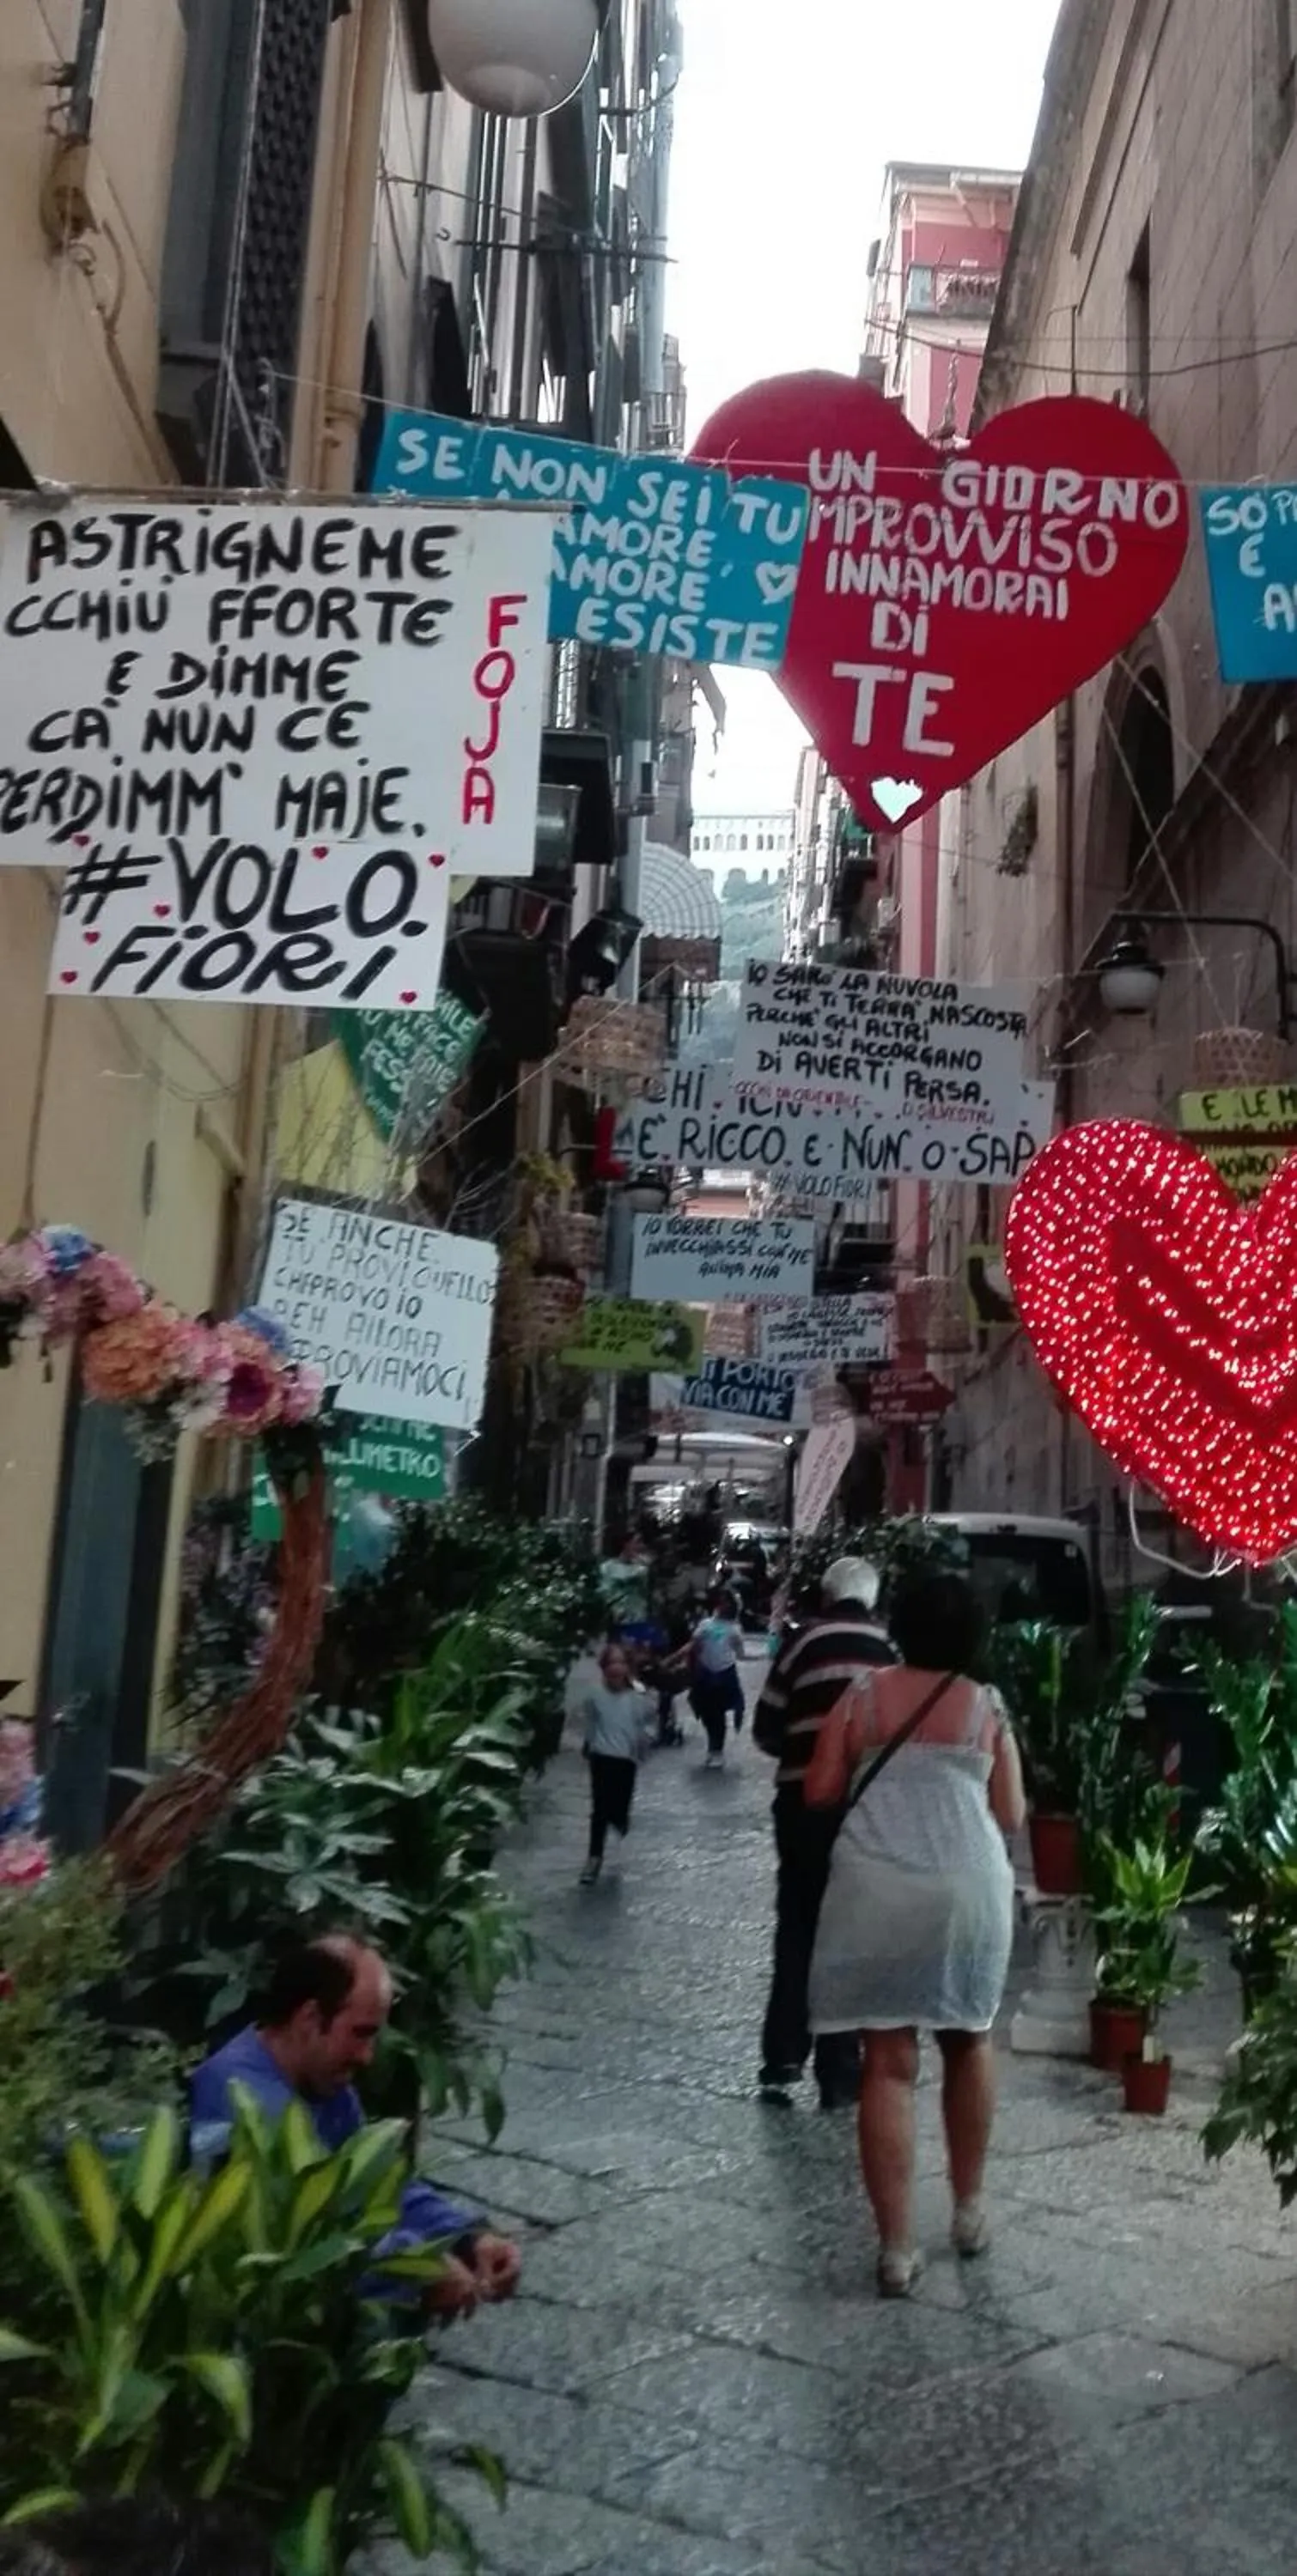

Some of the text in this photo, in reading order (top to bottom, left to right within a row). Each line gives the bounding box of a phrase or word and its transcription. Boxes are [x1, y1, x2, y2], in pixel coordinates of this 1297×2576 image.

[396, 428, 804, 544] SE NON SEI TU
[808, 447, 1179, 530] UN GIORNO
[27, 508, 461, 585] ASTRIGNEME
[808, 495, 1117, 578] MPROVVISO
[1239, 532, 1267, 579] E
[825, 550, 1069, 622] INNAMORAI
[208, 585, 454, 646] FFORTE
[575, 597, 780, 665] ESISTE
[871, 601, 929, 657] DI
[106, 645, 362, 703] E DIMME
[141, 702, 255, 754] NUN
[277, 702, 370, 752] CE
[461, 594, 528, 824] FOJA
[831, 662, 954, 757] TE
[91, 924, 398, 1001] FIORI
[746, 958, 769, 986] IO
[839, 969, 870, 992] LA
[876, 975, 959, 1002] NUVOLA
[773, 987, 812, 1005] CHE
[819, 989, 837, 1009] TI
[929, 1003, 1029, 1042] NASCOSTA
[824, 1013, 858, 1032] GLI
[864, 1018, 930, 1044] ALTRI
[757, 1048, 782, 1074] DI
[794, 1050, 894, 1091] AVERTI
[777, 1030, 983, 1073] NON SI ACCORGANO
[1202, 1091, 1222, 1122] E
[678, 1113, 786, 1165] RICCO
[841, 1124, 912, 1172] NUN
[959, 1130, 1037, 1177] SAP
[326, 1212, 441, 1263] ANCHE
[732, 1219, 763, 1239] CHE
[770, 1221, 793, 1240] TU
[395, 1288, 423, 1320] IO
[715, 1384, 755, 1413] CON
[757, 1388, 787, 1416] ME
[721, 1358, 796, 1392] PORTO
